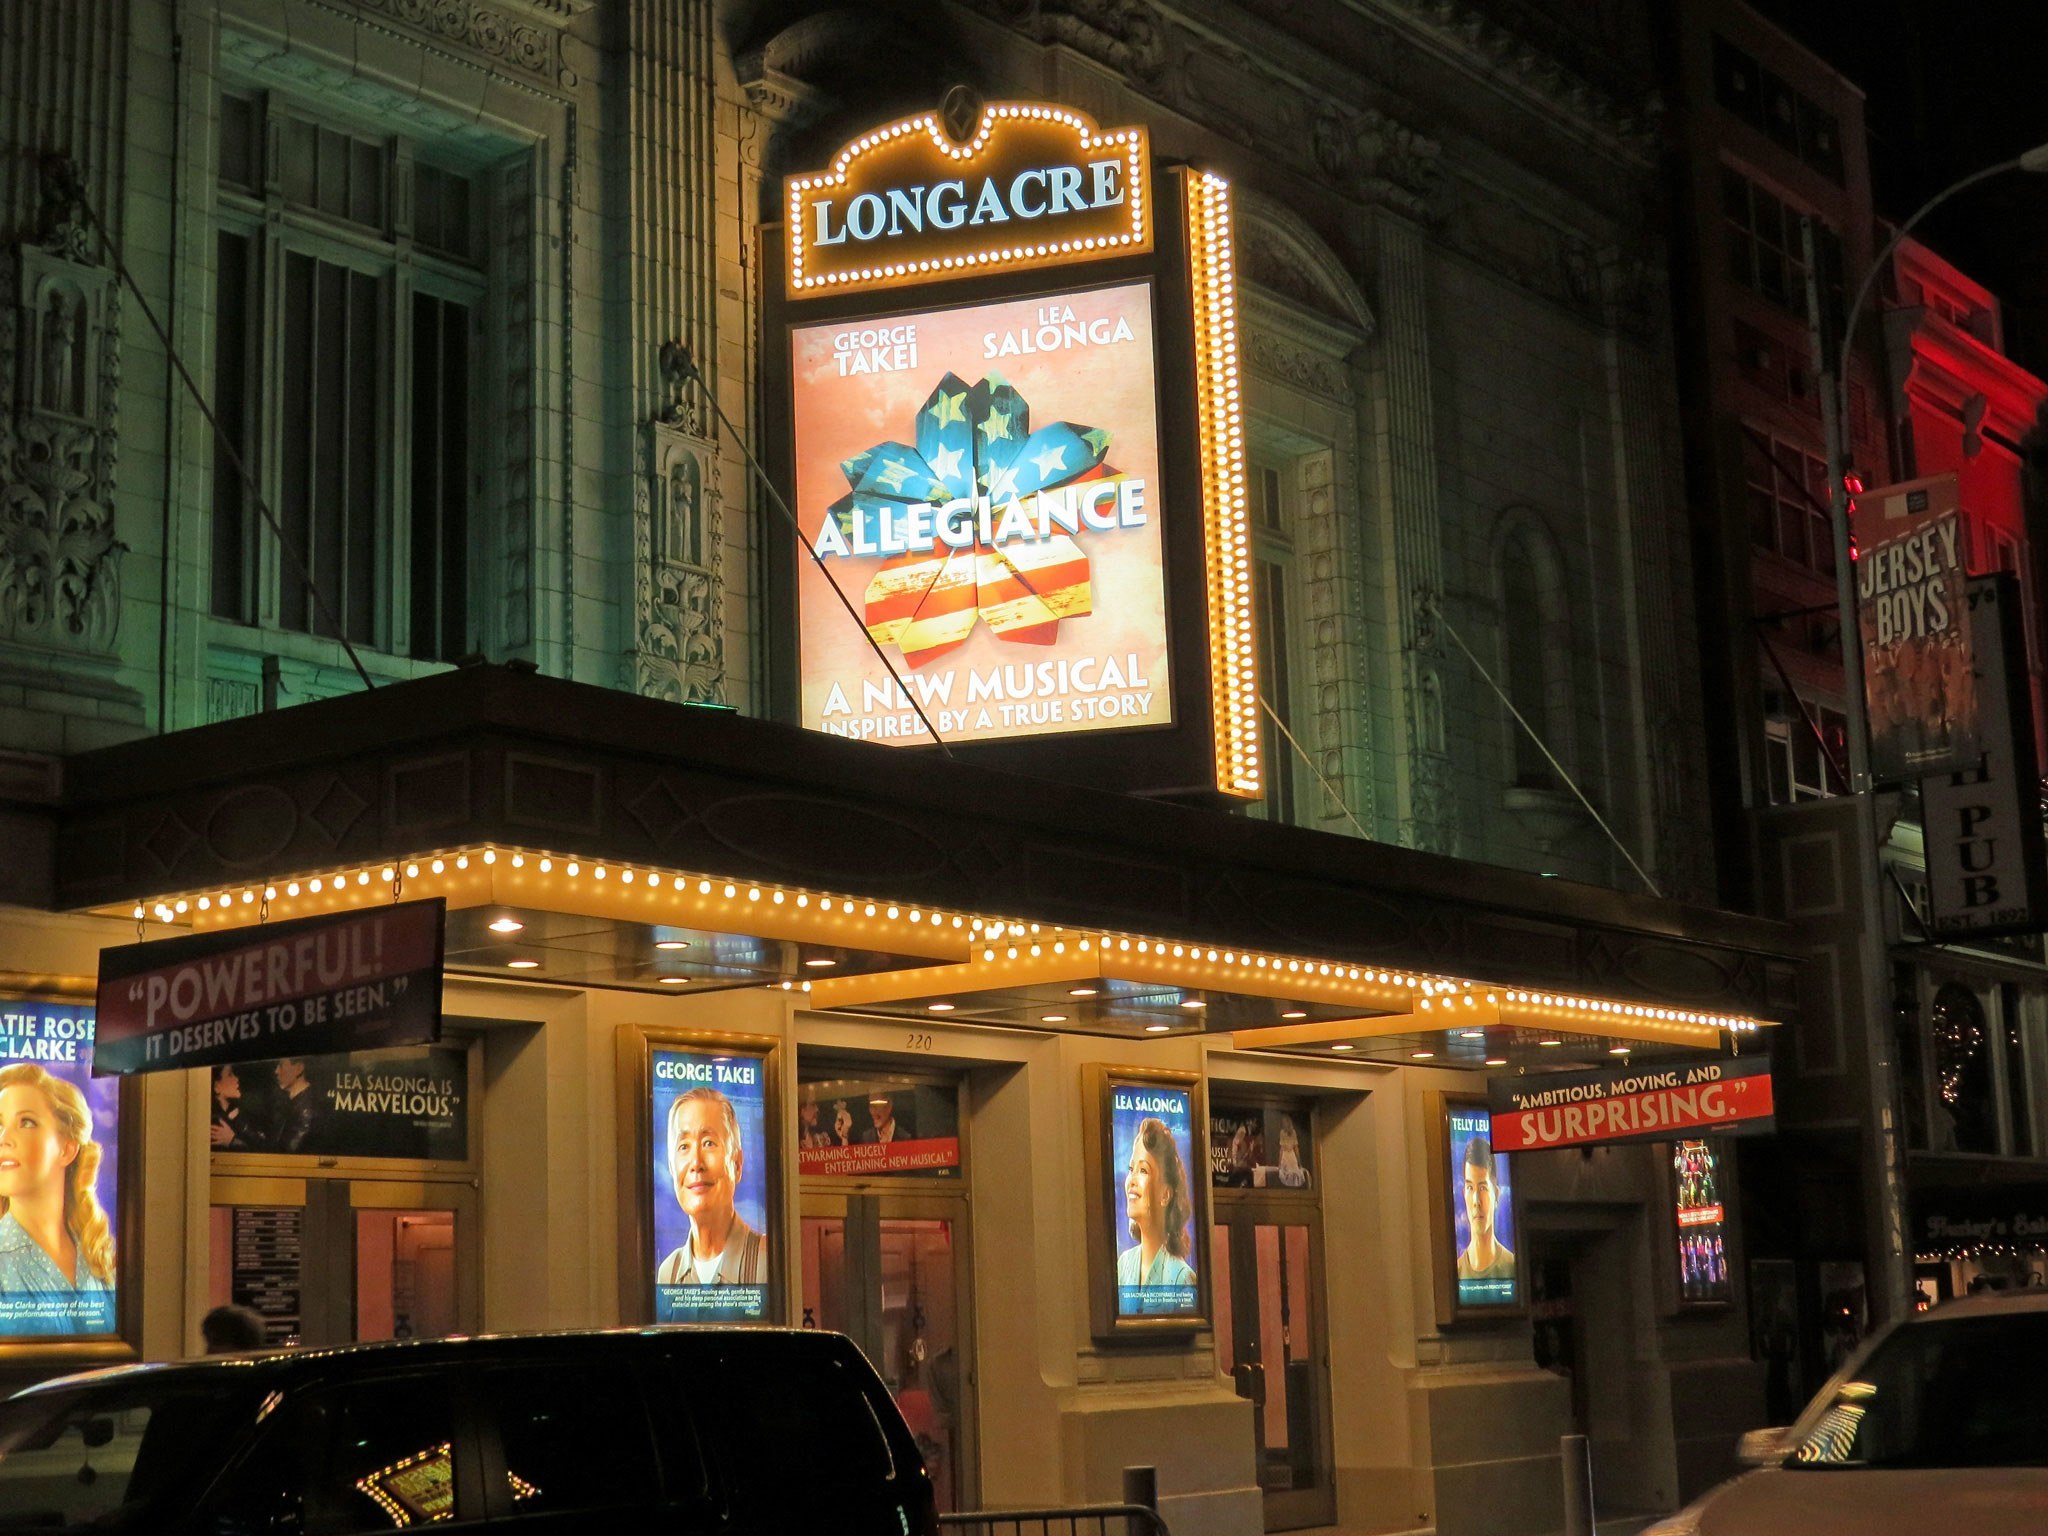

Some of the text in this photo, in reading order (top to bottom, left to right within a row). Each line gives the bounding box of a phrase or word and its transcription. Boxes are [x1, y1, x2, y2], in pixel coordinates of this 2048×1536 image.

[812, 159, 1125, 247] LONGACRE
[1038, 305, 1076, 327] LEA
[833, 325, 917, 352] GEORGE
[982, 316, 1135, 360] SALONGA
[833, 342, 918, 378] TAKEI
[810, 478, 1147, 561] ALLEGIANCE
[1861, 516, 1956, 599] JERSEY
[1877, 577, 1948, 646] BOYS
[823, 653, 1149, 717] A NEW MUSICAL
[821, 692, 1153, 740] INSPIRED BY A TRUE STORY
[1955, 805, 2000, 907] PUB
[129, 919, 385, 1027] “POWERFUL!
[44, 1017, 95, 1040] ROSE
[146, 1034, 164, 1061] IT
[170, 1011, 260, 1056] DESERVES
[267, 1004, 296, 1033] TO
[304, 996, 327, 1026] BE
[906, 1034, 932, 1051] 220
[336, 1072, 453, 1095] LEA SALONGA IS
[656, 1060, 755, 1085] GEORGE TAKEI
[1512, 1065, 1722, 1110] “AMBITIOUS, MOVING, AND
[327, 1089, 460, 1117] “MARVELOUS.”
[1115, 1095, 1184, 1114] LEA SALONGA
[1521, 1081, 1748, 1145] SURPRISING.”
[1452, 1117, 1489, 1132] TELLY LEU
[799, 1145, 887, 1163] TWARMING, HUGELY
[825, 1157, 887, 1174] ENTERTAINING
[889, 1155, 908, 1168] NEW
